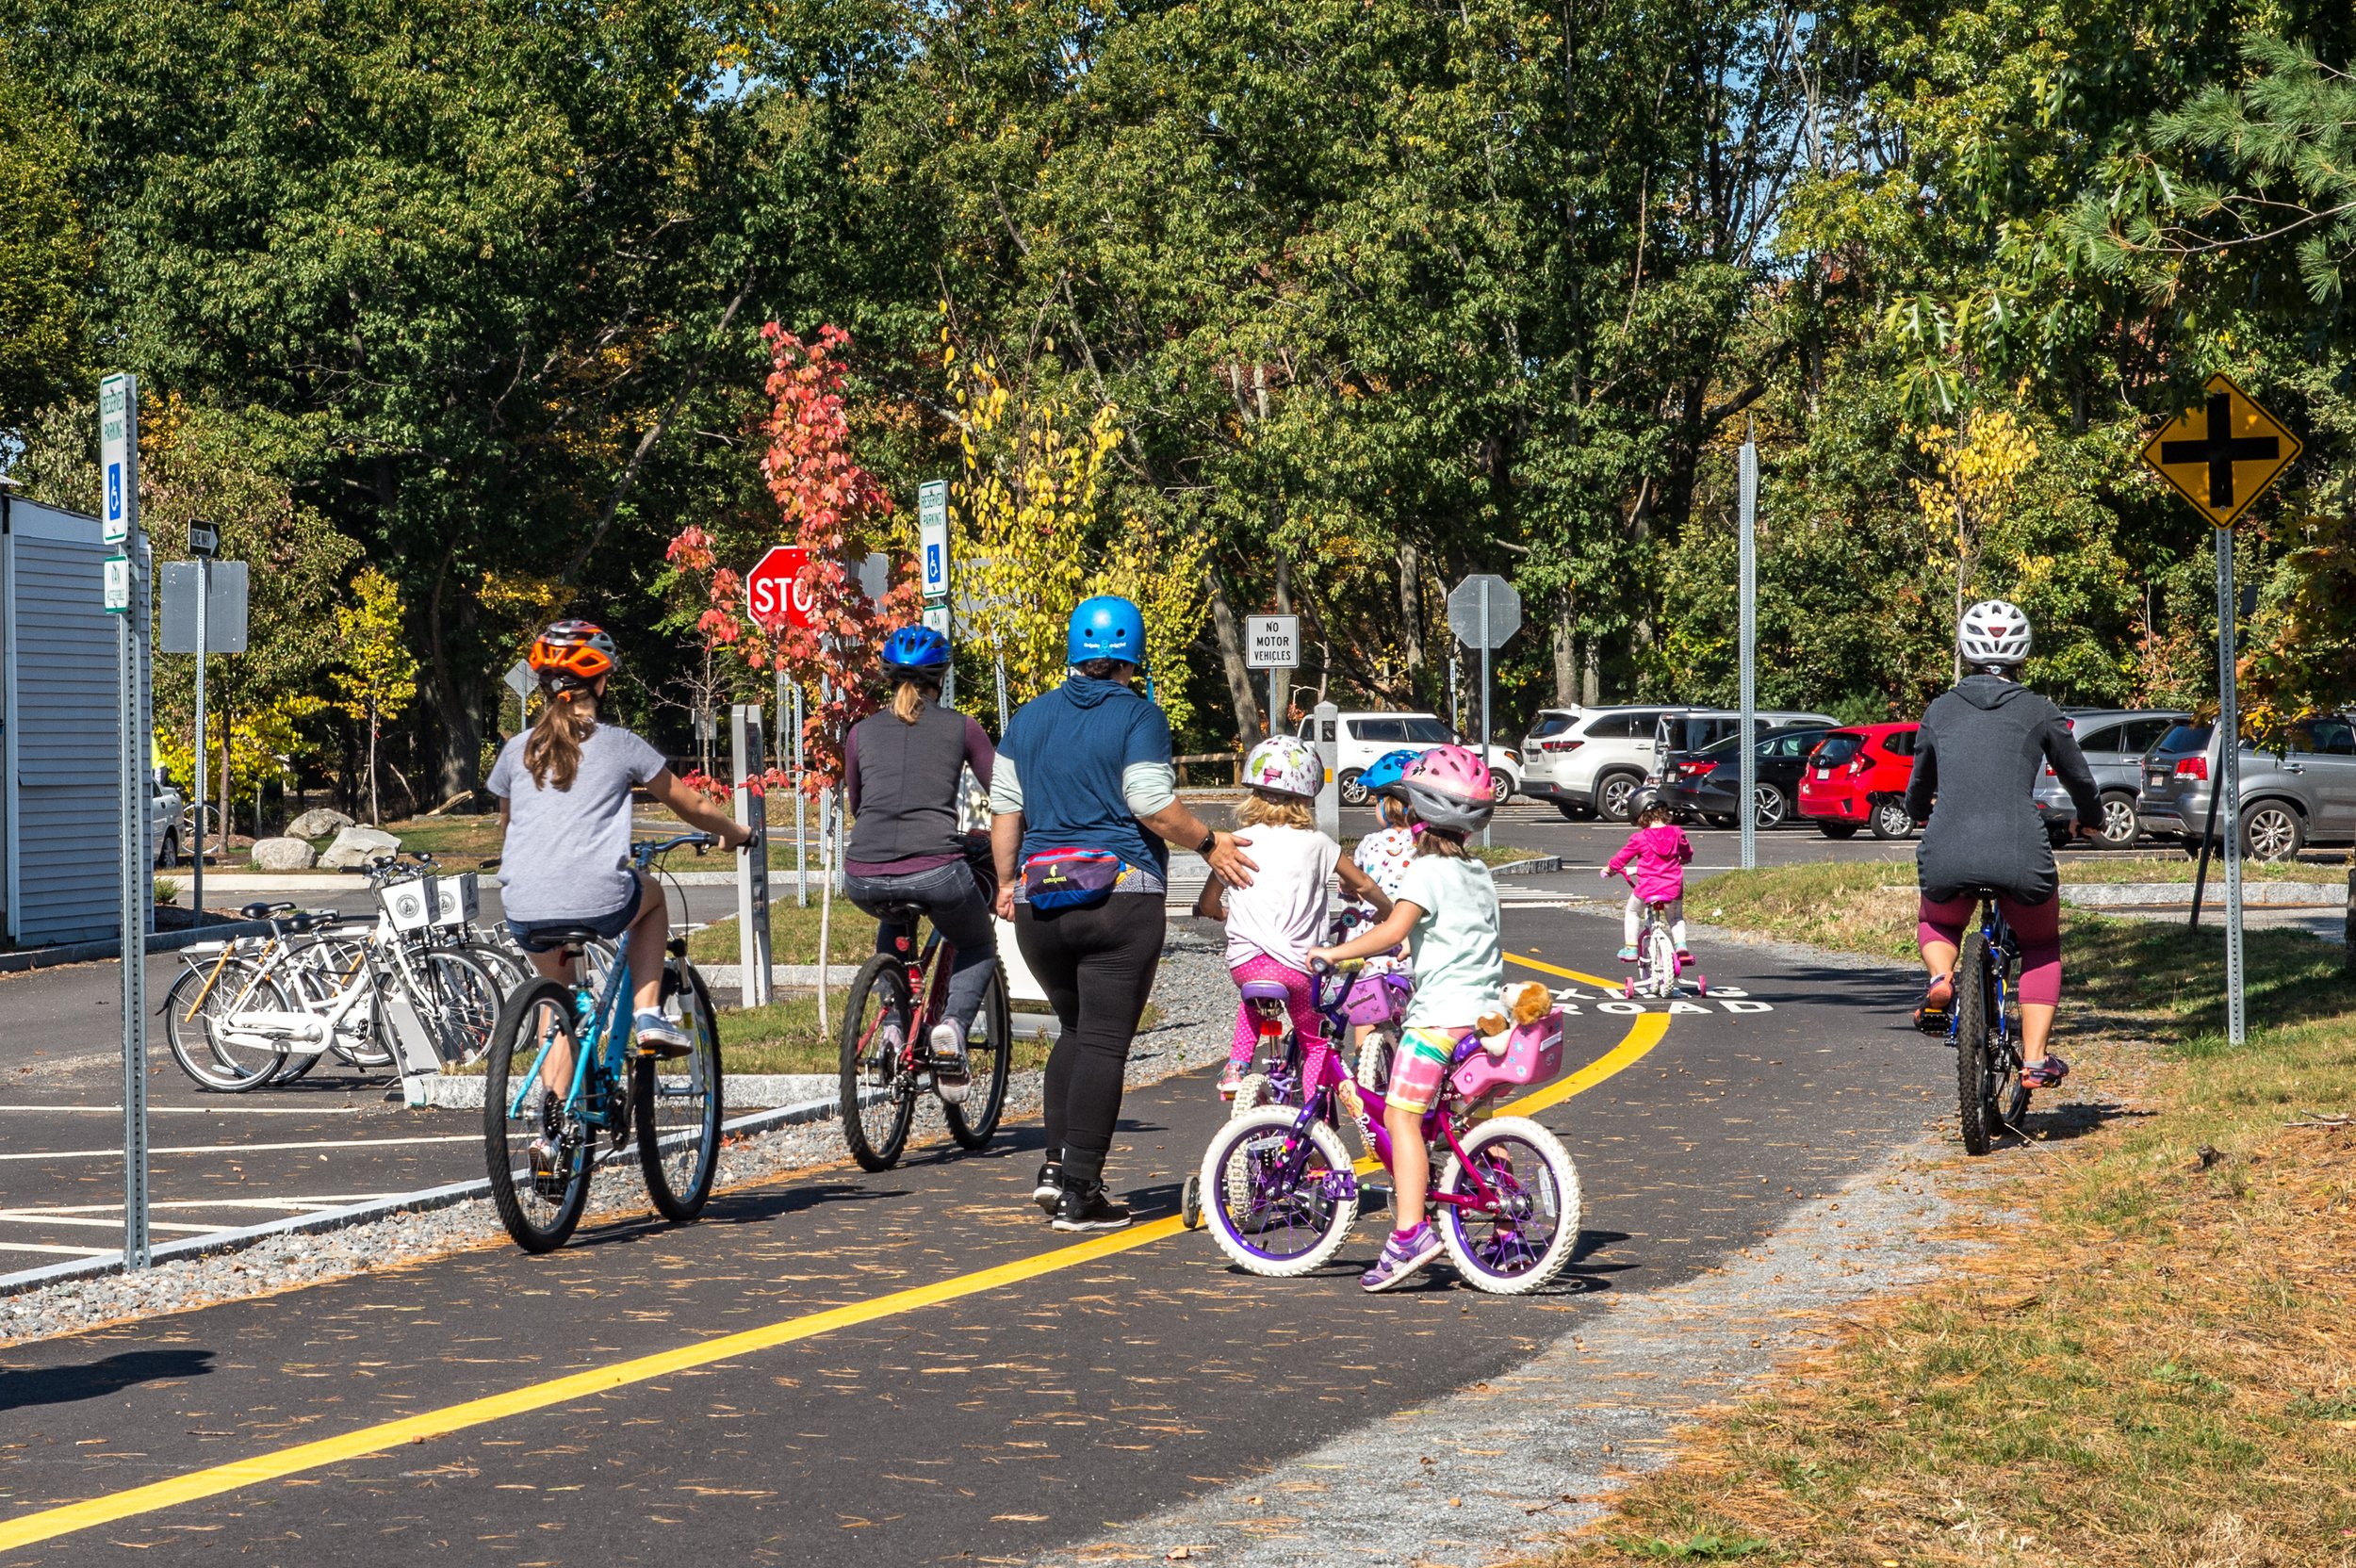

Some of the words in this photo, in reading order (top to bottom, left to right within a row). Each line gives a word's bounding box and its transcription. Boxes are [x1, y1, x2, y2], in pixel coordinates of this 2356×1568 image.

[103, 391, 123, 415] RESERVED
[105, 419, 123, 442] PARKING
[921, 493, 943, 508] RESERVED
[924, 512, 941, 528] PARKING
[755, 578, 812, 612] STO
[1266, 622, 1279, 632] NO
[1256, 636, 1289, 646] MOTOR
[1254, 650, 1291, 661] VEHICLES
